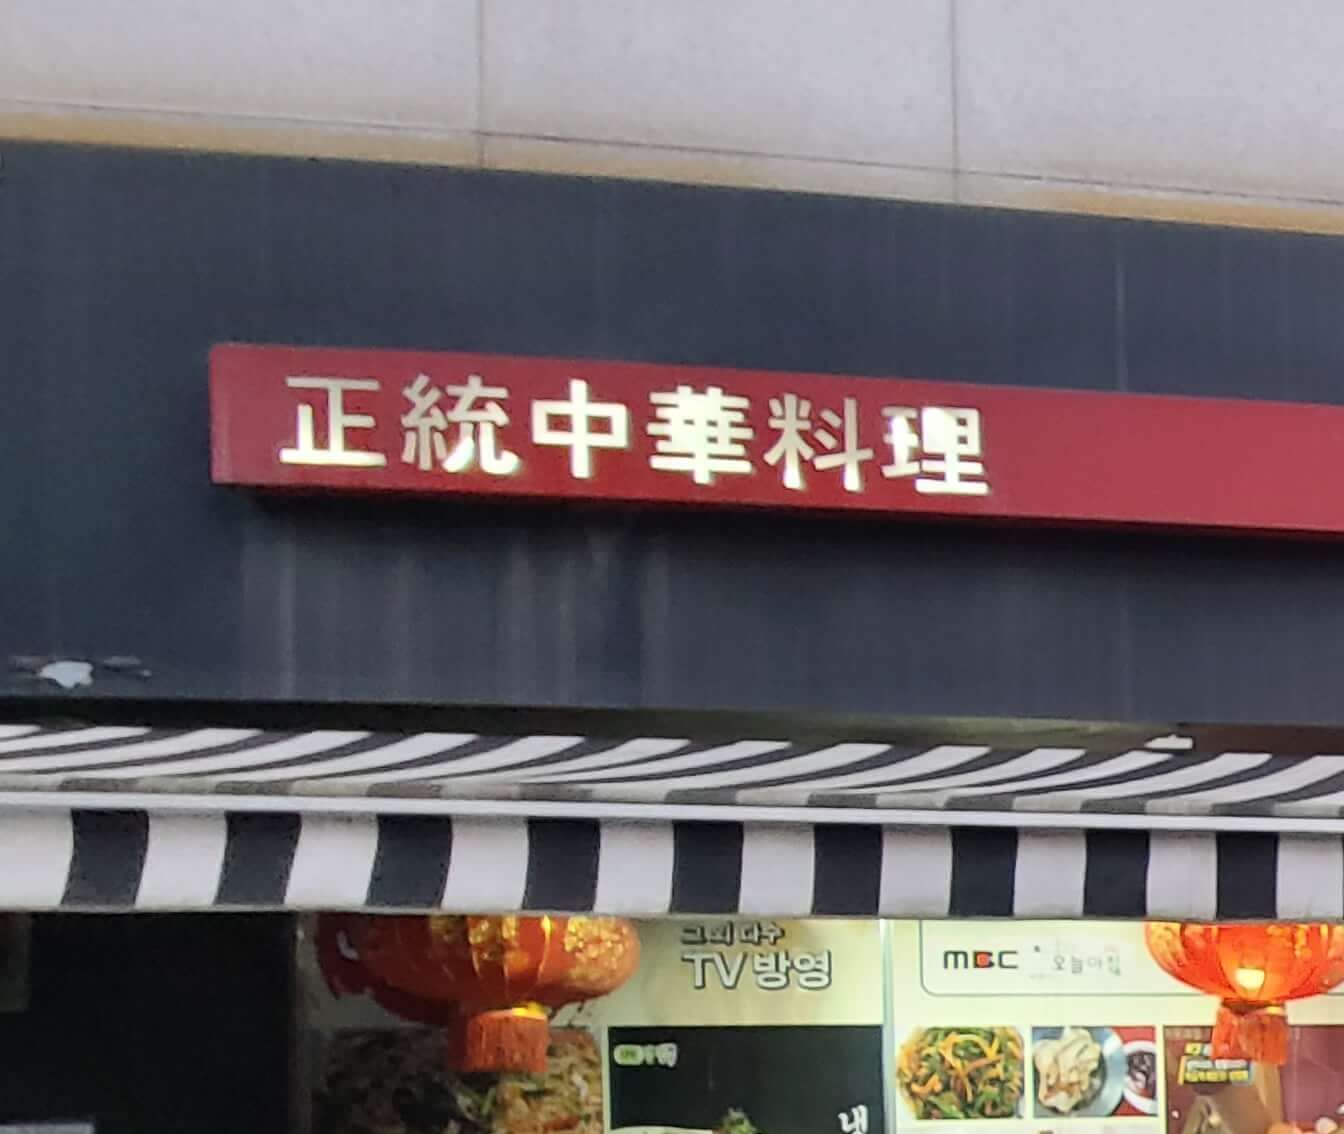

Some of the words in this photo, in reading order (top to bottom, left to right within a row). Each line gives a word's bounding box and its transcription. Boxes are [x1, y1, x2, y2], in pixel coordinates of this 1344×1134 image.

[278, 373, 990, 496] 正統中華料理
[681, 951, 746, 989] TV
[752, 948, 832, 989] 방영
